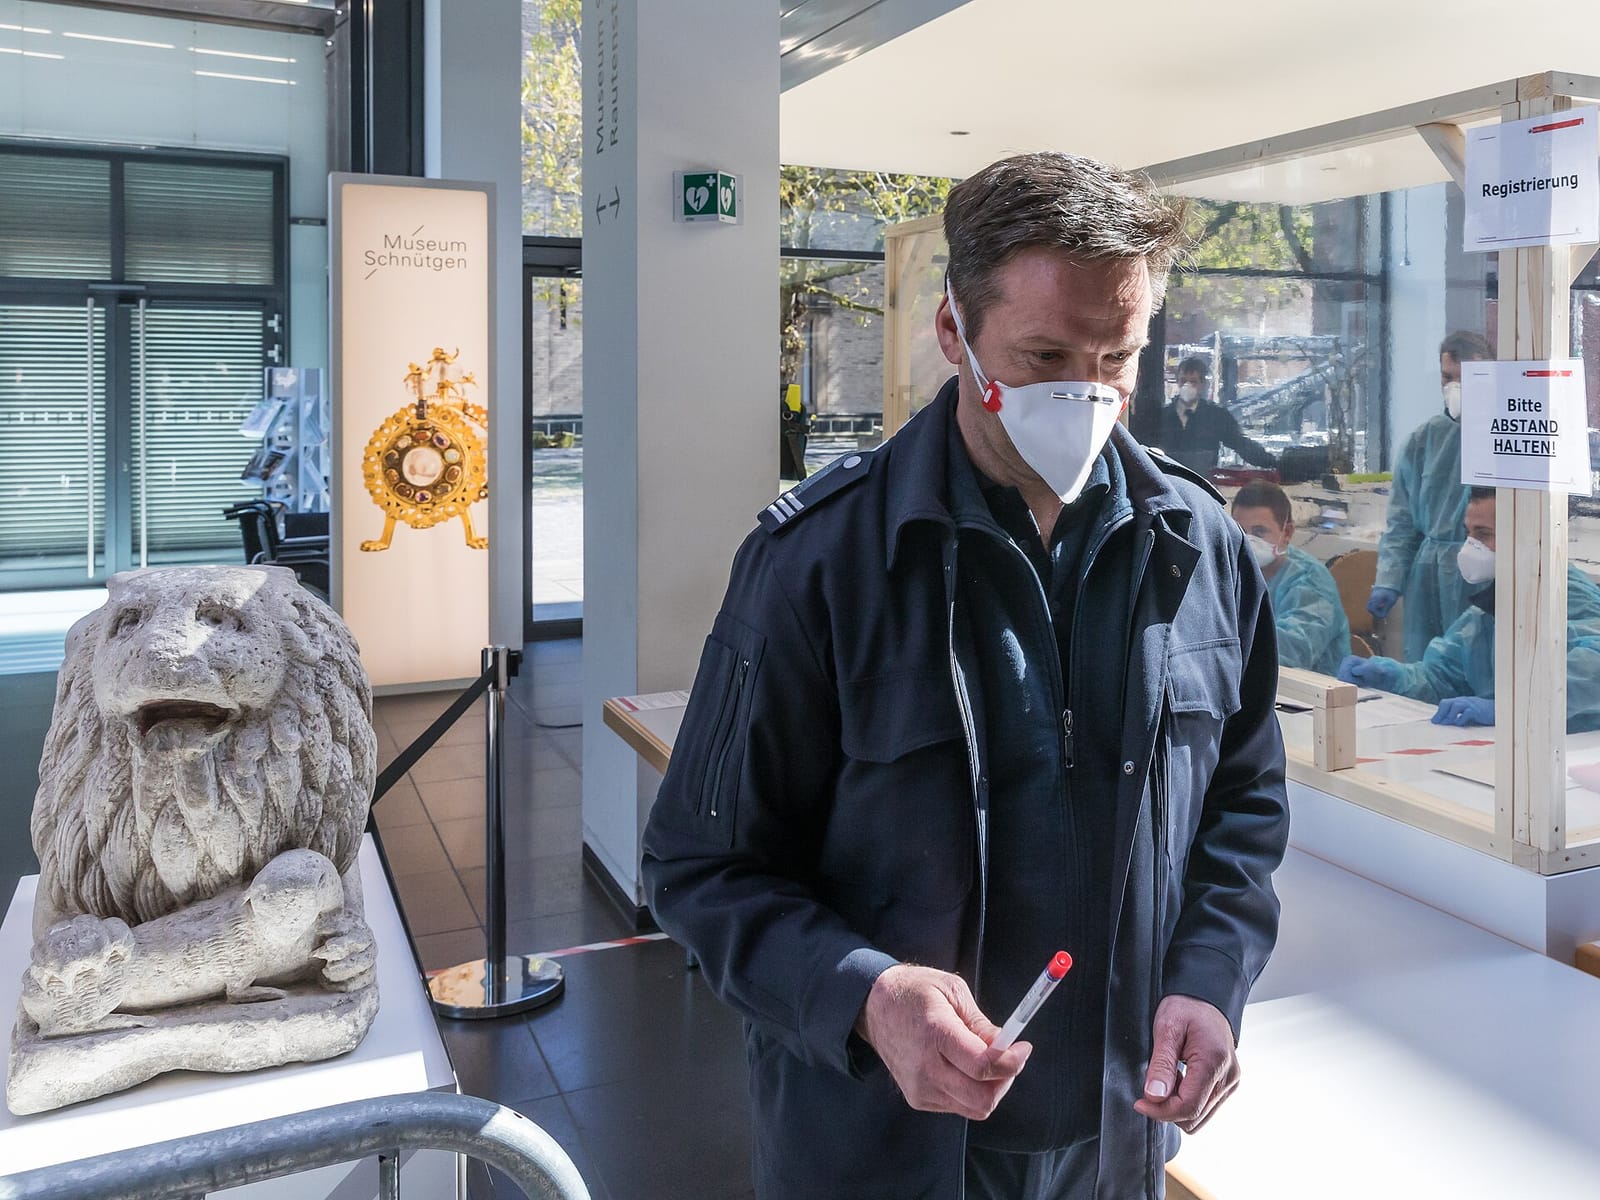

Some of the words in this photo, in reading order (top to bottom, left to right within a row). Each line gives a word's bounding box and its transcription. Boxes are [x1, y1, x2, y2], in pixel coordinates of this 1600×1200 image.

[596, 20, 604, 154] Museum
[1482, 174, 1578, 198] Registrierung
[384, 234, 467, 252] Museum
[364, 250, 467, 272] Schnütgen
[1507, 398, 1542, 412] Bitte
[1490, 418, 1559, 434] ABSTAND
[1493, 438, 1556, 455] HALTEN!
